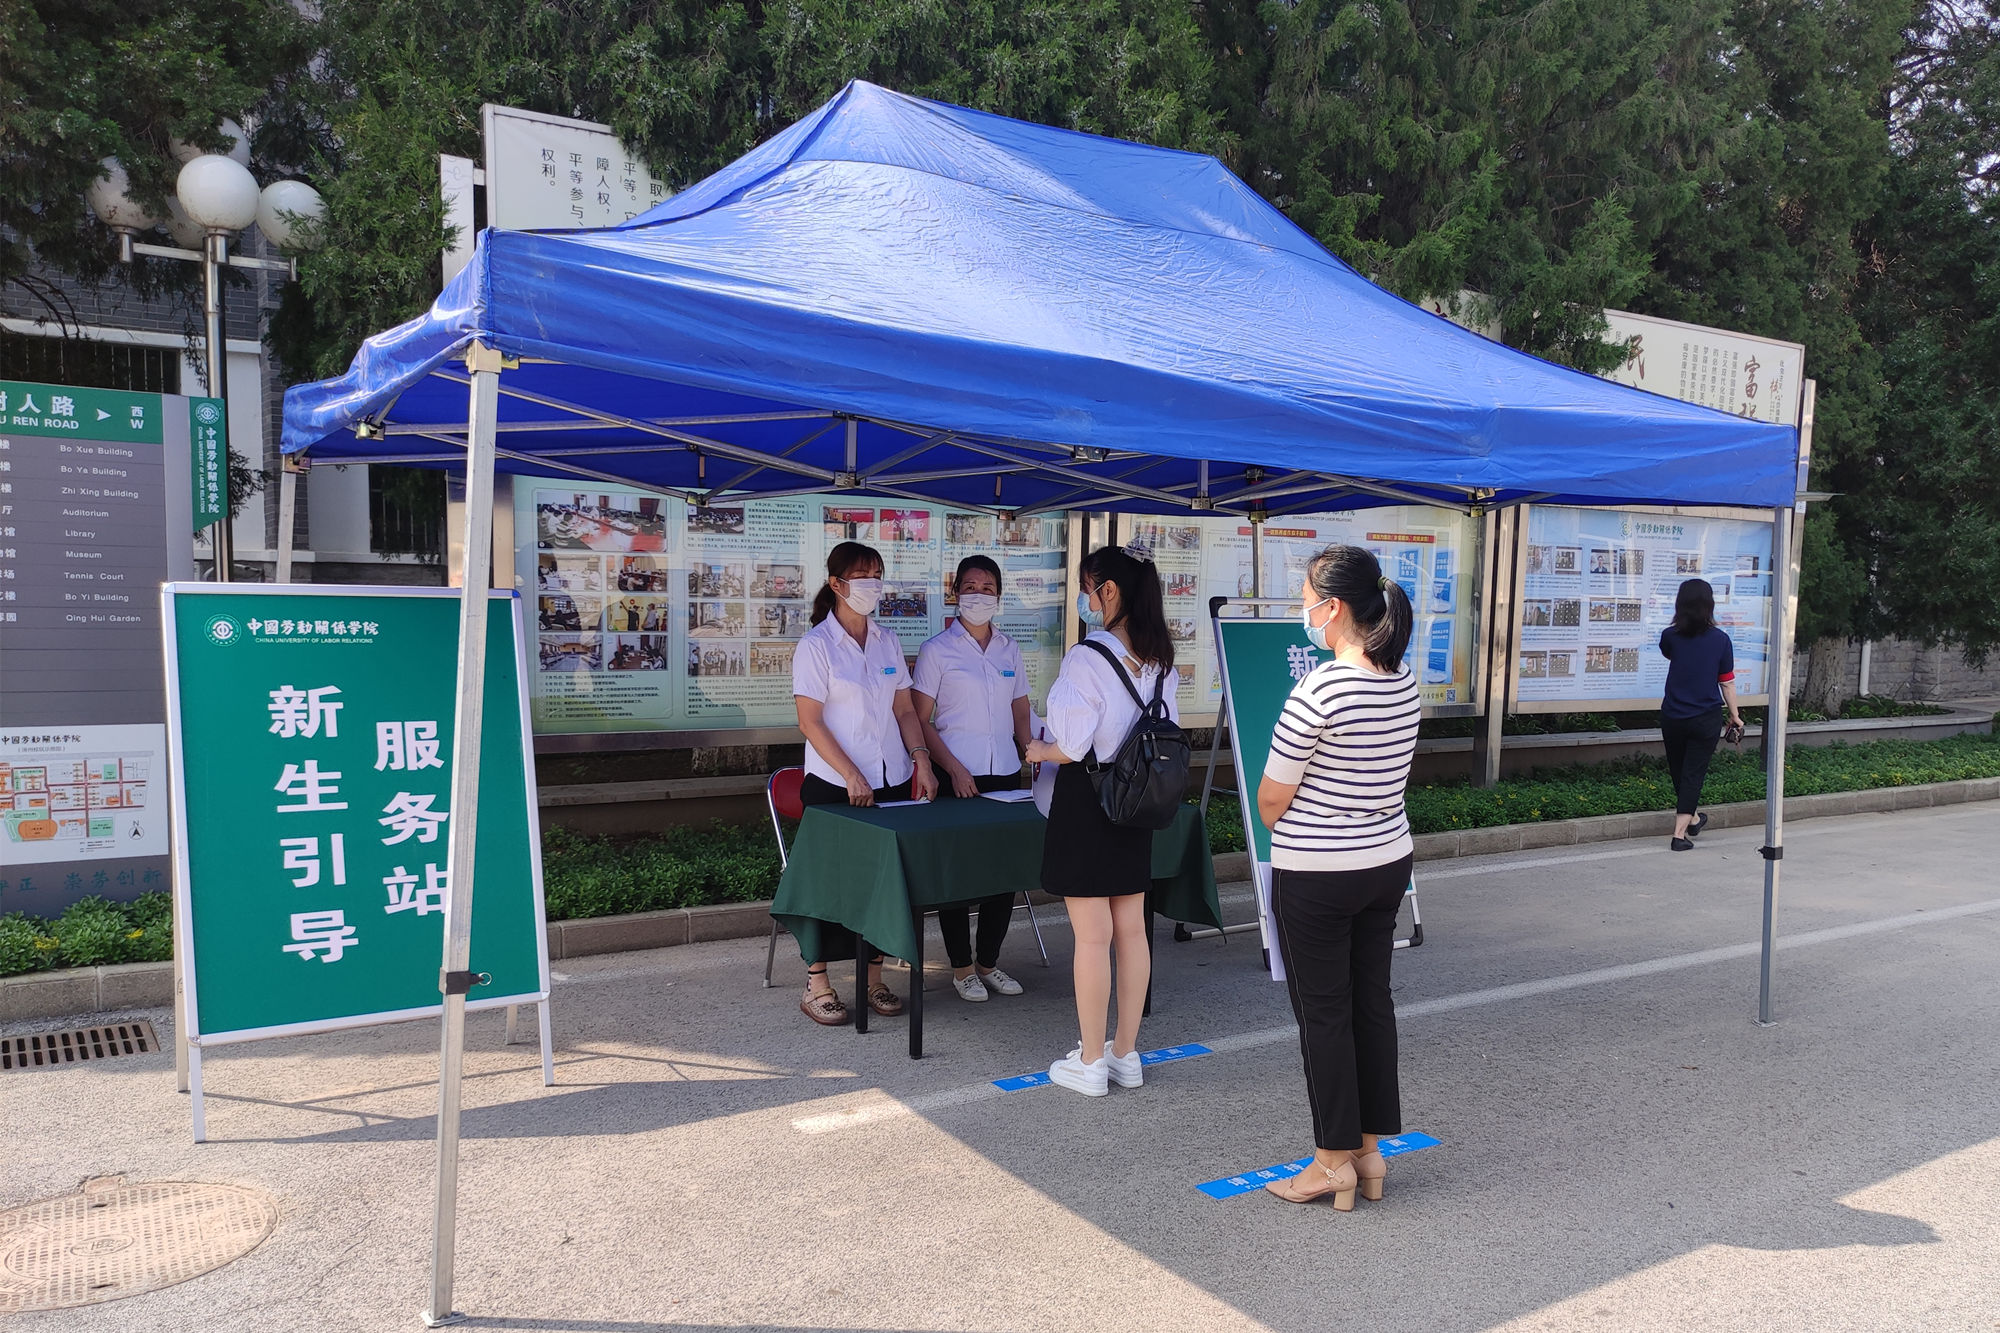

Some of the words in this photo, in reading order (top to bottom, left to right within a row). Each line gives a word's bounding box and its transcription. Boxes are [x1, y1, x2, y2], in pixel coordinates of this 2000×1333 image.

[541, 147, 556, 187] 权利。
[568, 152, 584, 227] 平等参与、
[596, 156, 612, 228] 障人权，
[130, 406, 144, 417] 西
[13, 416, 39, 427] REN
[44, 418, 79, 430] ROAD
[130, 419, 144, 429] W
[60, 444, 72, 453] Bo
[76, 446, 94, 454] Xue
[97, 447, 133, 457] Building
[60, 465, 73, 473] Bo
[76, 466, 88, 474] Ya
[92, 467, 127, 477] Building
[62, 487, 76, 495] Zhi
[80, 488, 100, 497] Xing
[103, 489, 139, 499] Building
[62, 508, 109, 517] Auditorium
[0, 527, 16, 537] 馆
[65, 529, 96, 539] Library
[65, 551, 102, 559] Museum
[0, 569, 15, 579] 场
[64, 571, 94, 580] Tennis
[94, 594, 129, 602] Building
[1286, 644, 1319, 681] 新
[268, 684, 359, 964] 新生引导
[373, 720, 450, 917] 服务站
